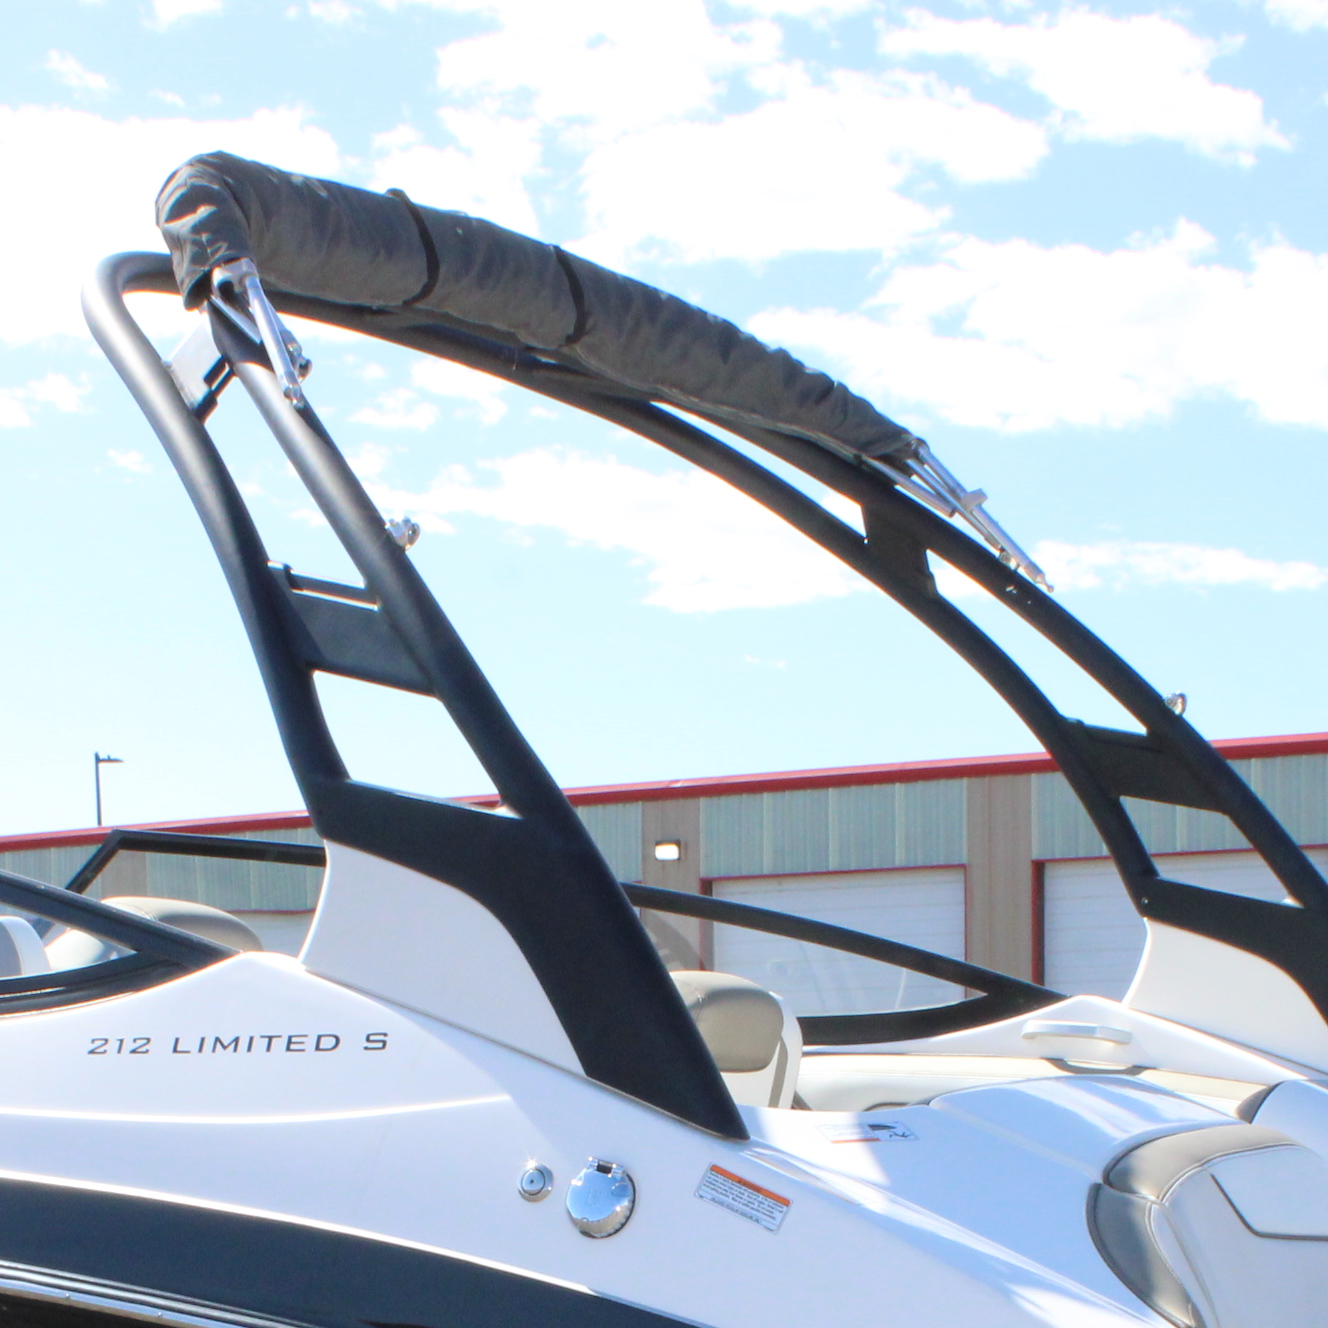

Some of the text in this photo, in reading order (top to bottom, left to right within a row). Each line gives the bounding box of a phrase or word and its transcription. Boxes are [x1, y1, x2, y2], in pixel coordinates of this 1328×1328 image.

[87, 1032, 389, 1055] 212 LIMITED S
